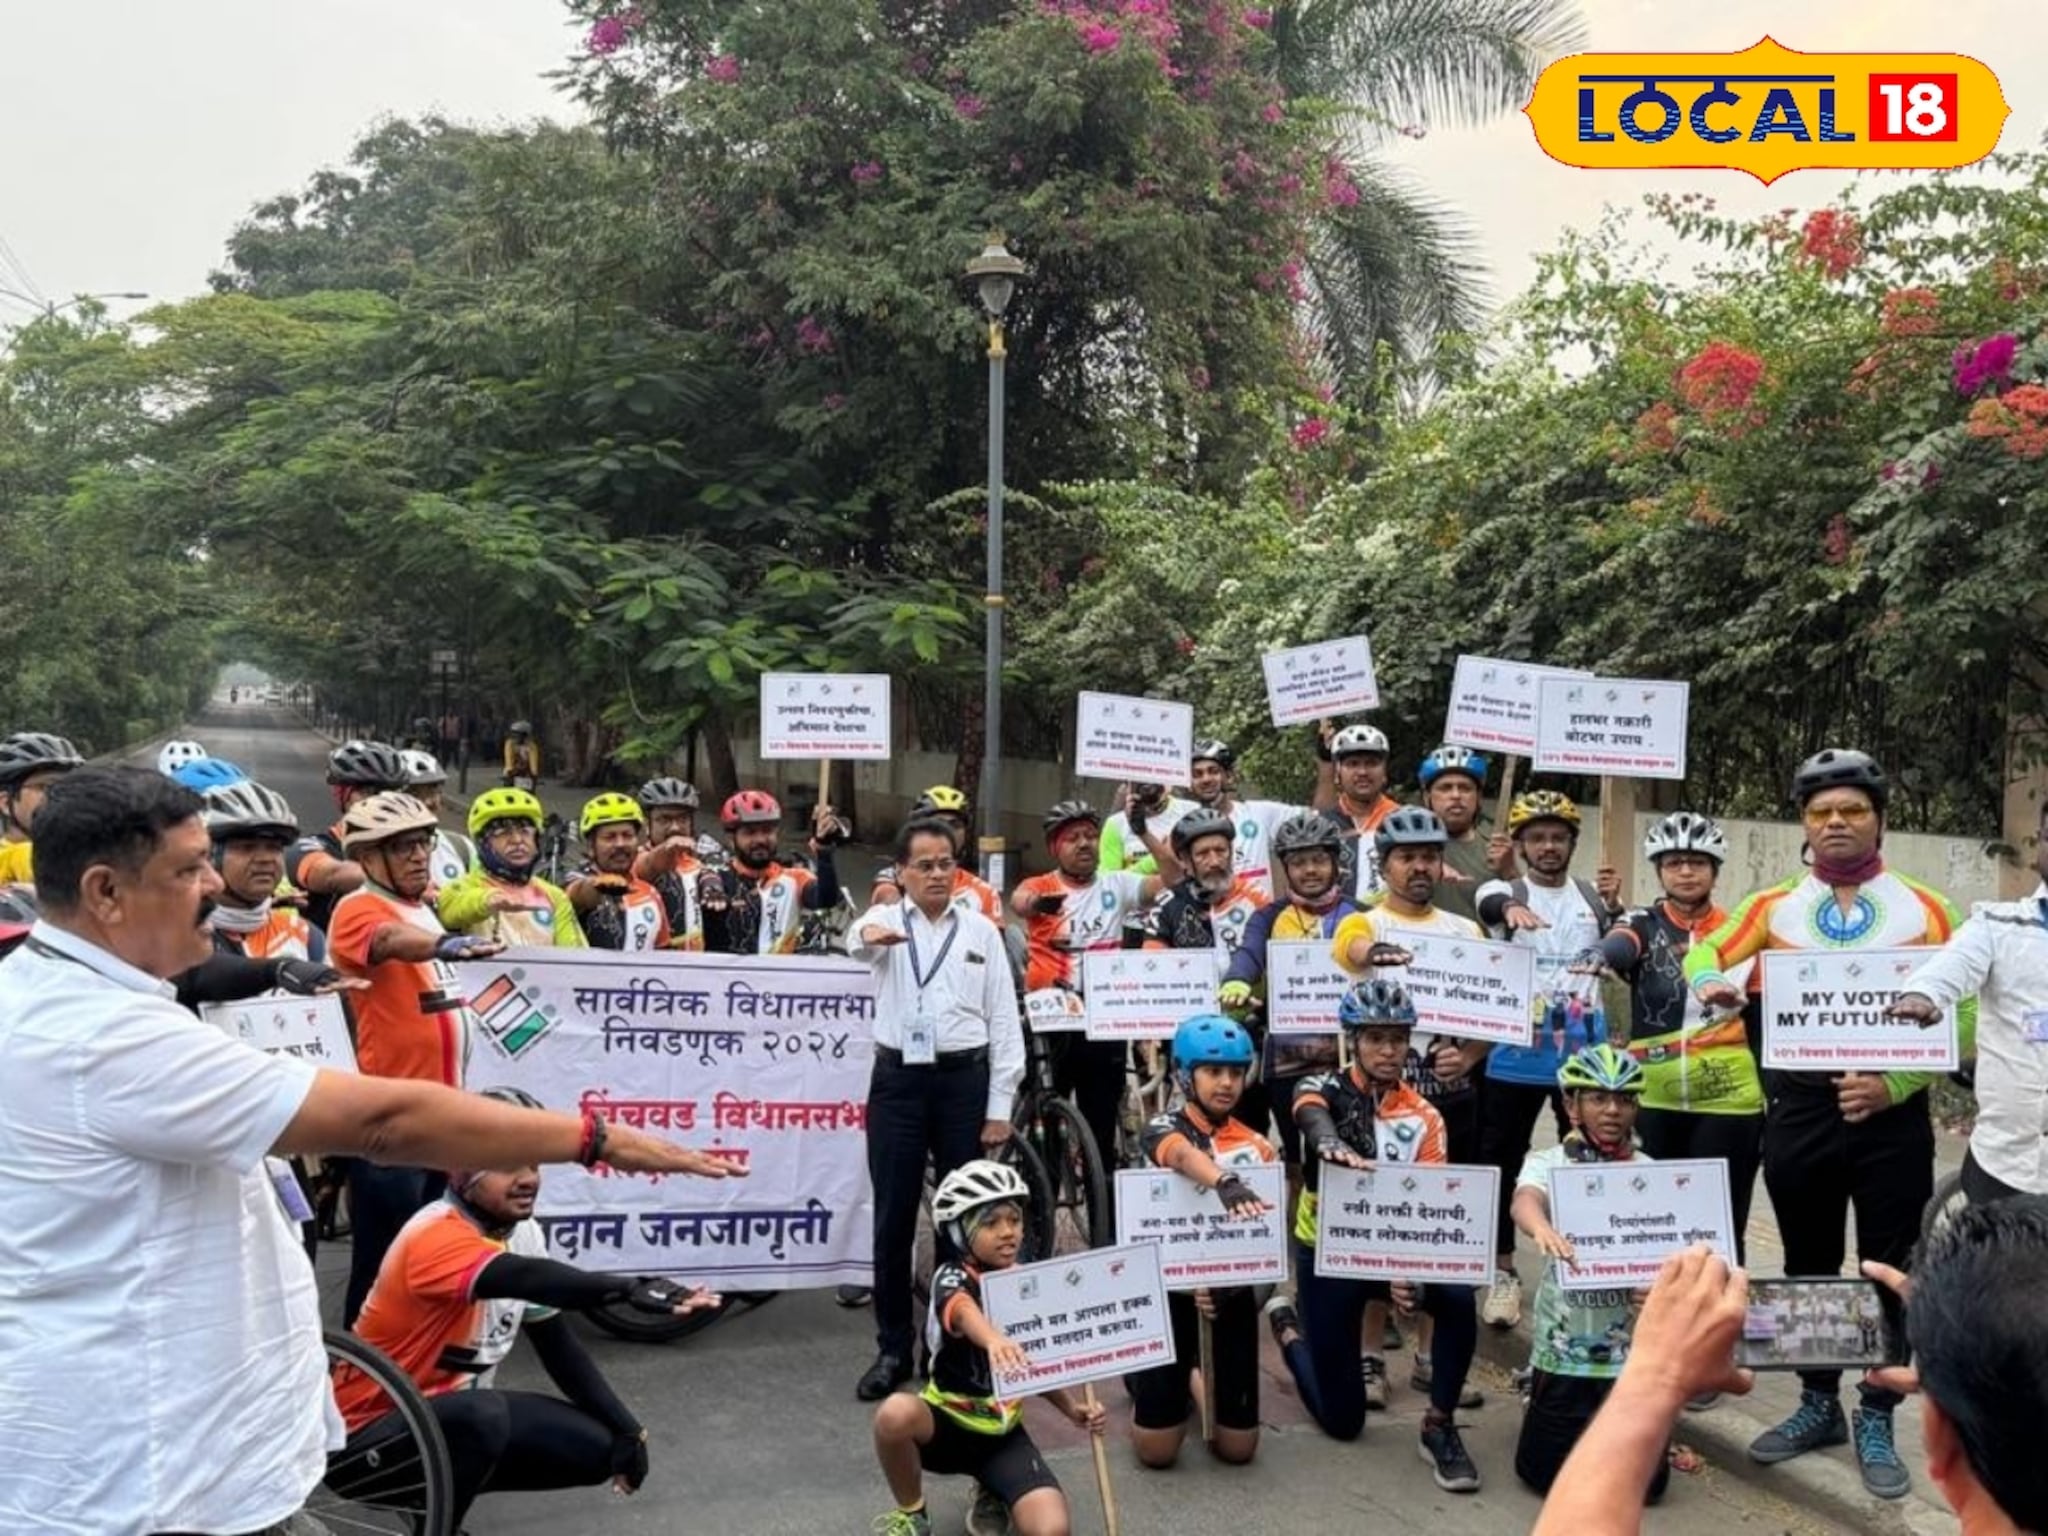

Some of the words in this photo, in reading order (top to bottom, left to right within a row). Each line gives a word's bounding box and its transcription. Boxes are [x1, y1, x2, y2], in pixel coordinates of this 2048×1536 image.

[574, 978, 710, 1018] सार्वत्रिक
[725, 980, 876, 1019] विधानसभा
[1801, 991, 1835, 1006] MY
[1777, 1012, 1810, 1027] MY
[601, 1015, 745, 1066] निवडणूक
[763, 1030, 850, 1061] २०२४
[639, 1199, 832, 1260] जनजागृती
[1328, 1225, 1372, 1242] ताकद
[1047, 1311, 1067, 1327] मत
[1052, 1327, 1093, 1347] मतदान
